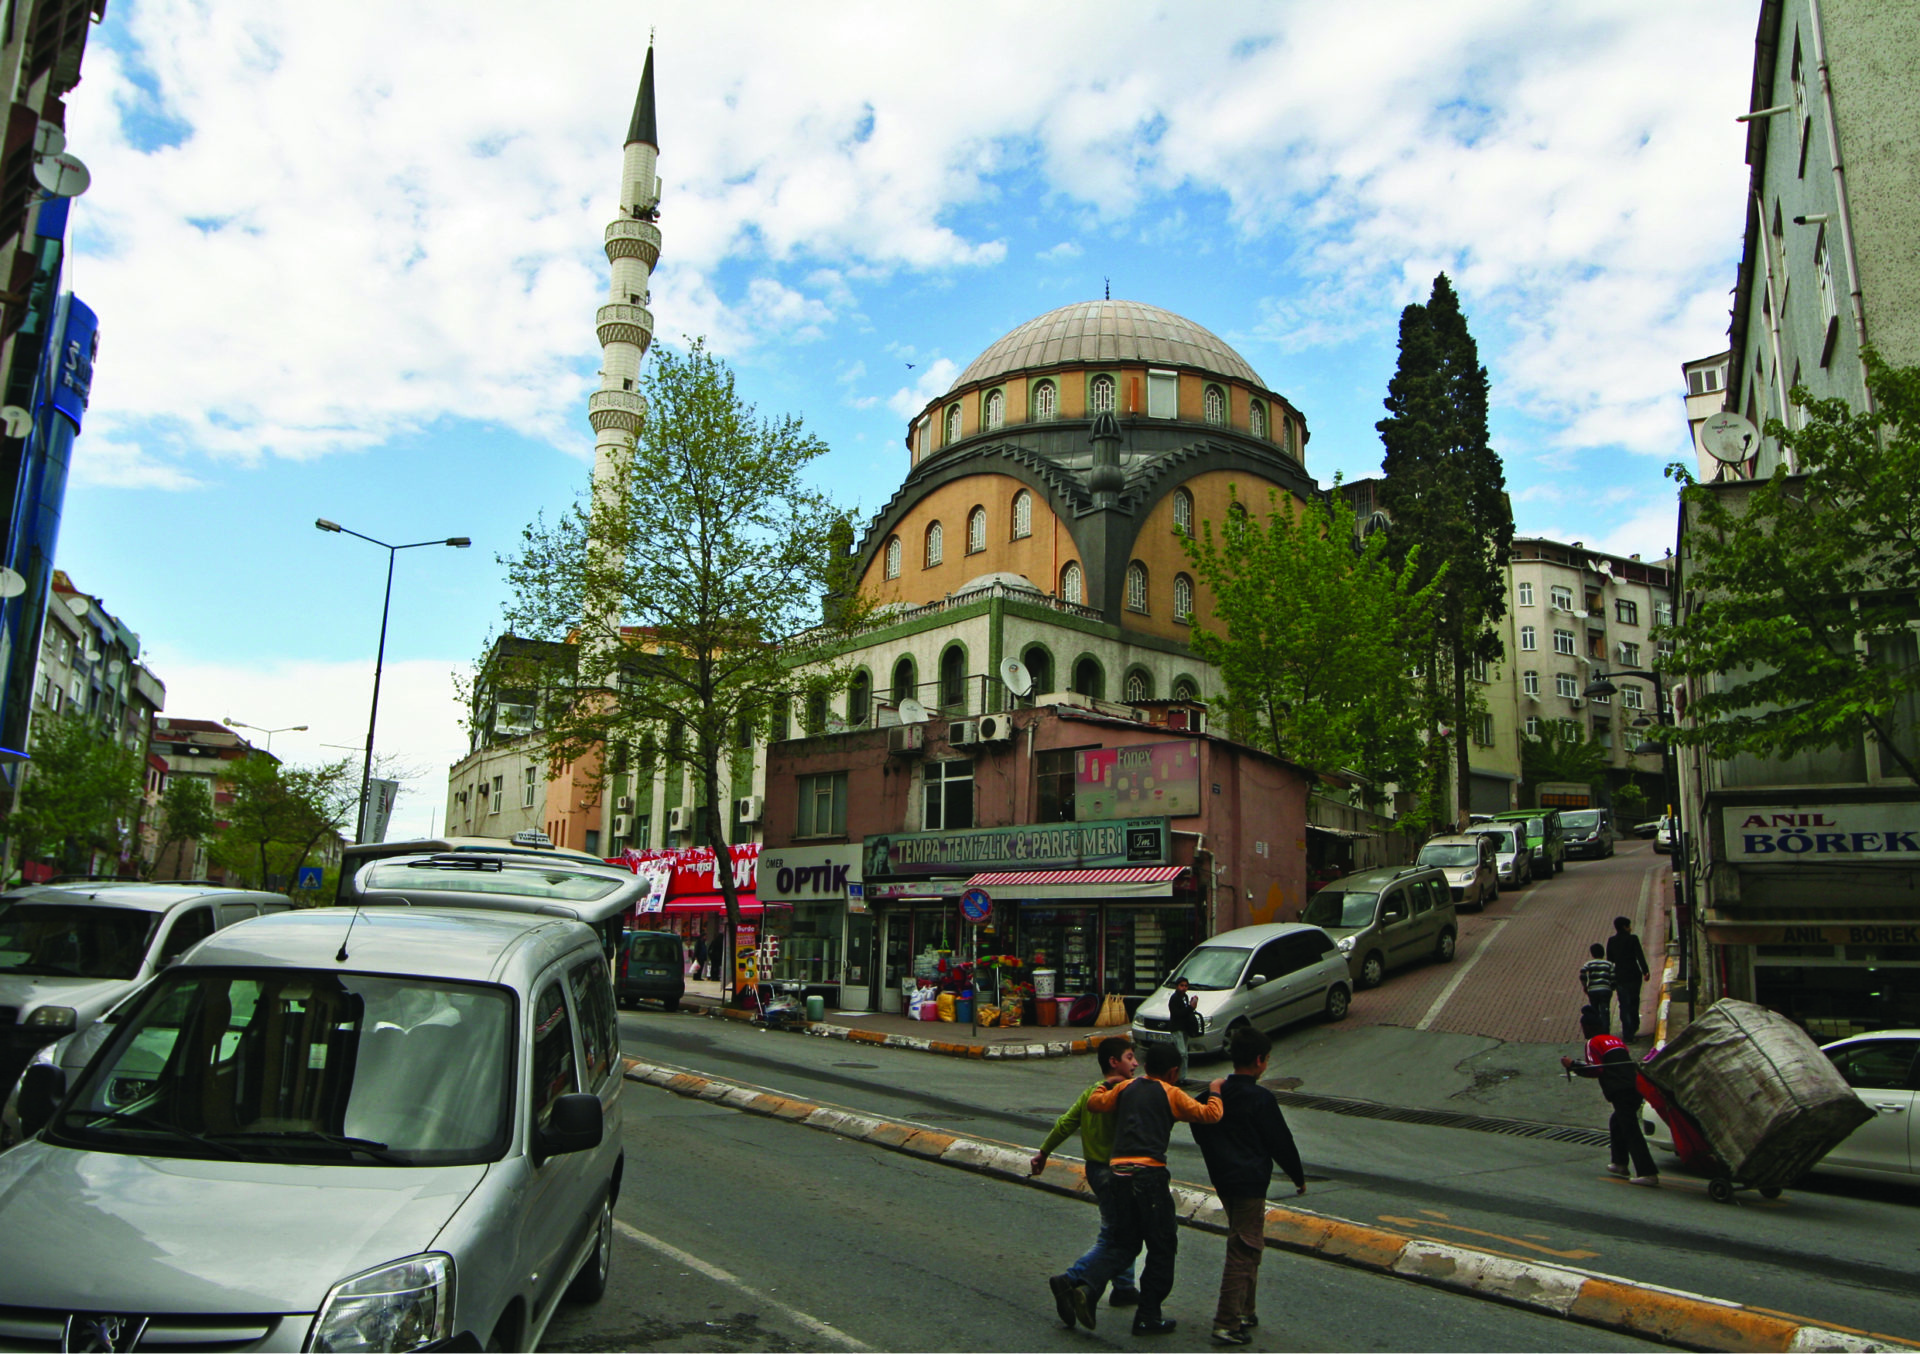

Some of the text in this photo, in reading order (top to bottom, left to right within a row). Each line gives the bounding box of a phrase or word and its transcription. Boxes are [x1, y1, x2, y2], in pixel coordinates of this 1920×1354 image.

[1118, 747, 1153, 769] Fonex
[1741, 813, 1836, 828] ANIL
[897, 838, 941, 864] TEMPA
[1015, 831, 1027, 860] &
[1742, 829, 1920, 854] BÖREK
[766, 857, 784, 869] ÖMER
[776, 858, 850, 894] OPTİK
[1783, 926, 1829, 944] ANIL
